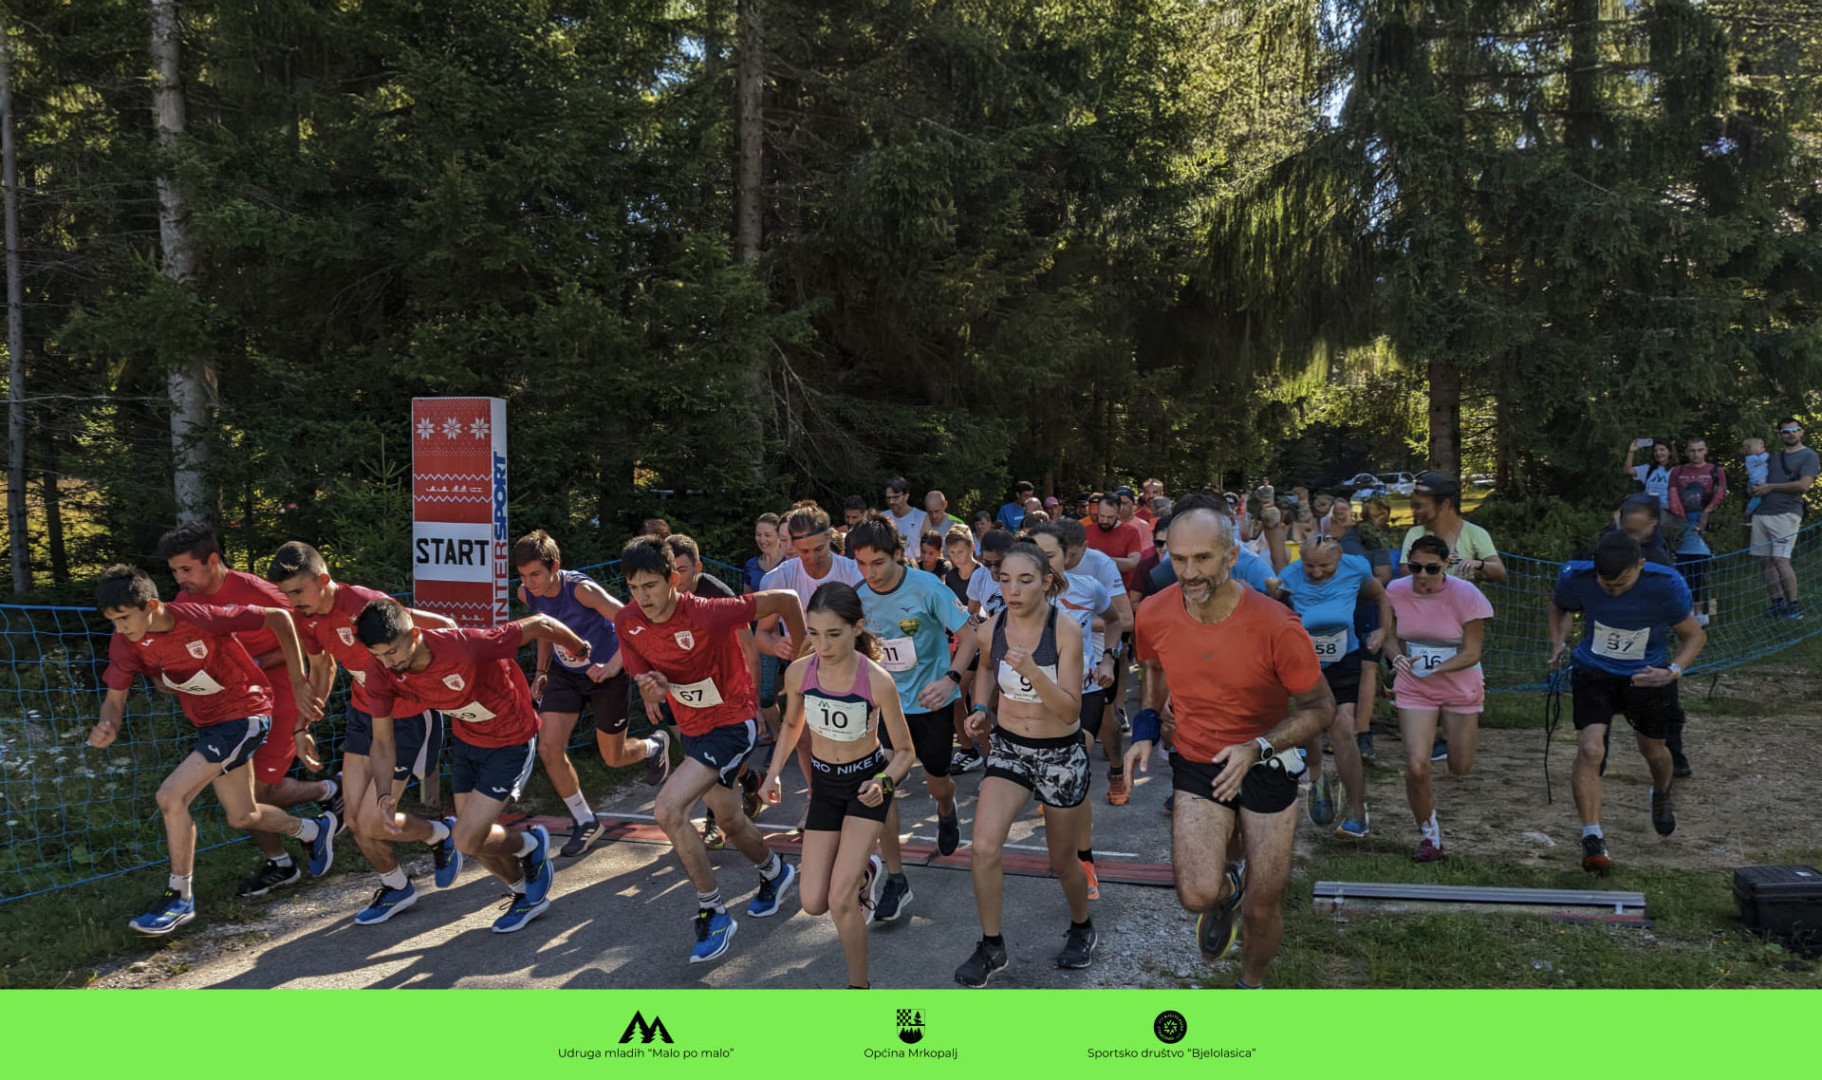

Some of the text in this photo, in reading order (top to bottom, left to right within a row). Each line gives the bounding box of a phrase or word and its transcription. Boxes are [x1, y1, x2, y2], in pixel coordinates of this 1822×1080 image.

[493, 451, 509, 624] INTERSPORT
[415, 538, 490, 566] START
[882, 646, 899, 662] 11
[1315, 643, 1337, 655] 58
[1421, 655, 1442, 669] 16
[1019, 674, 1033, 692] 9
[679, 689, 704, 703] 67
[820, 708, 848, 729] 10
[837, 757, 874, 775] NIKE
